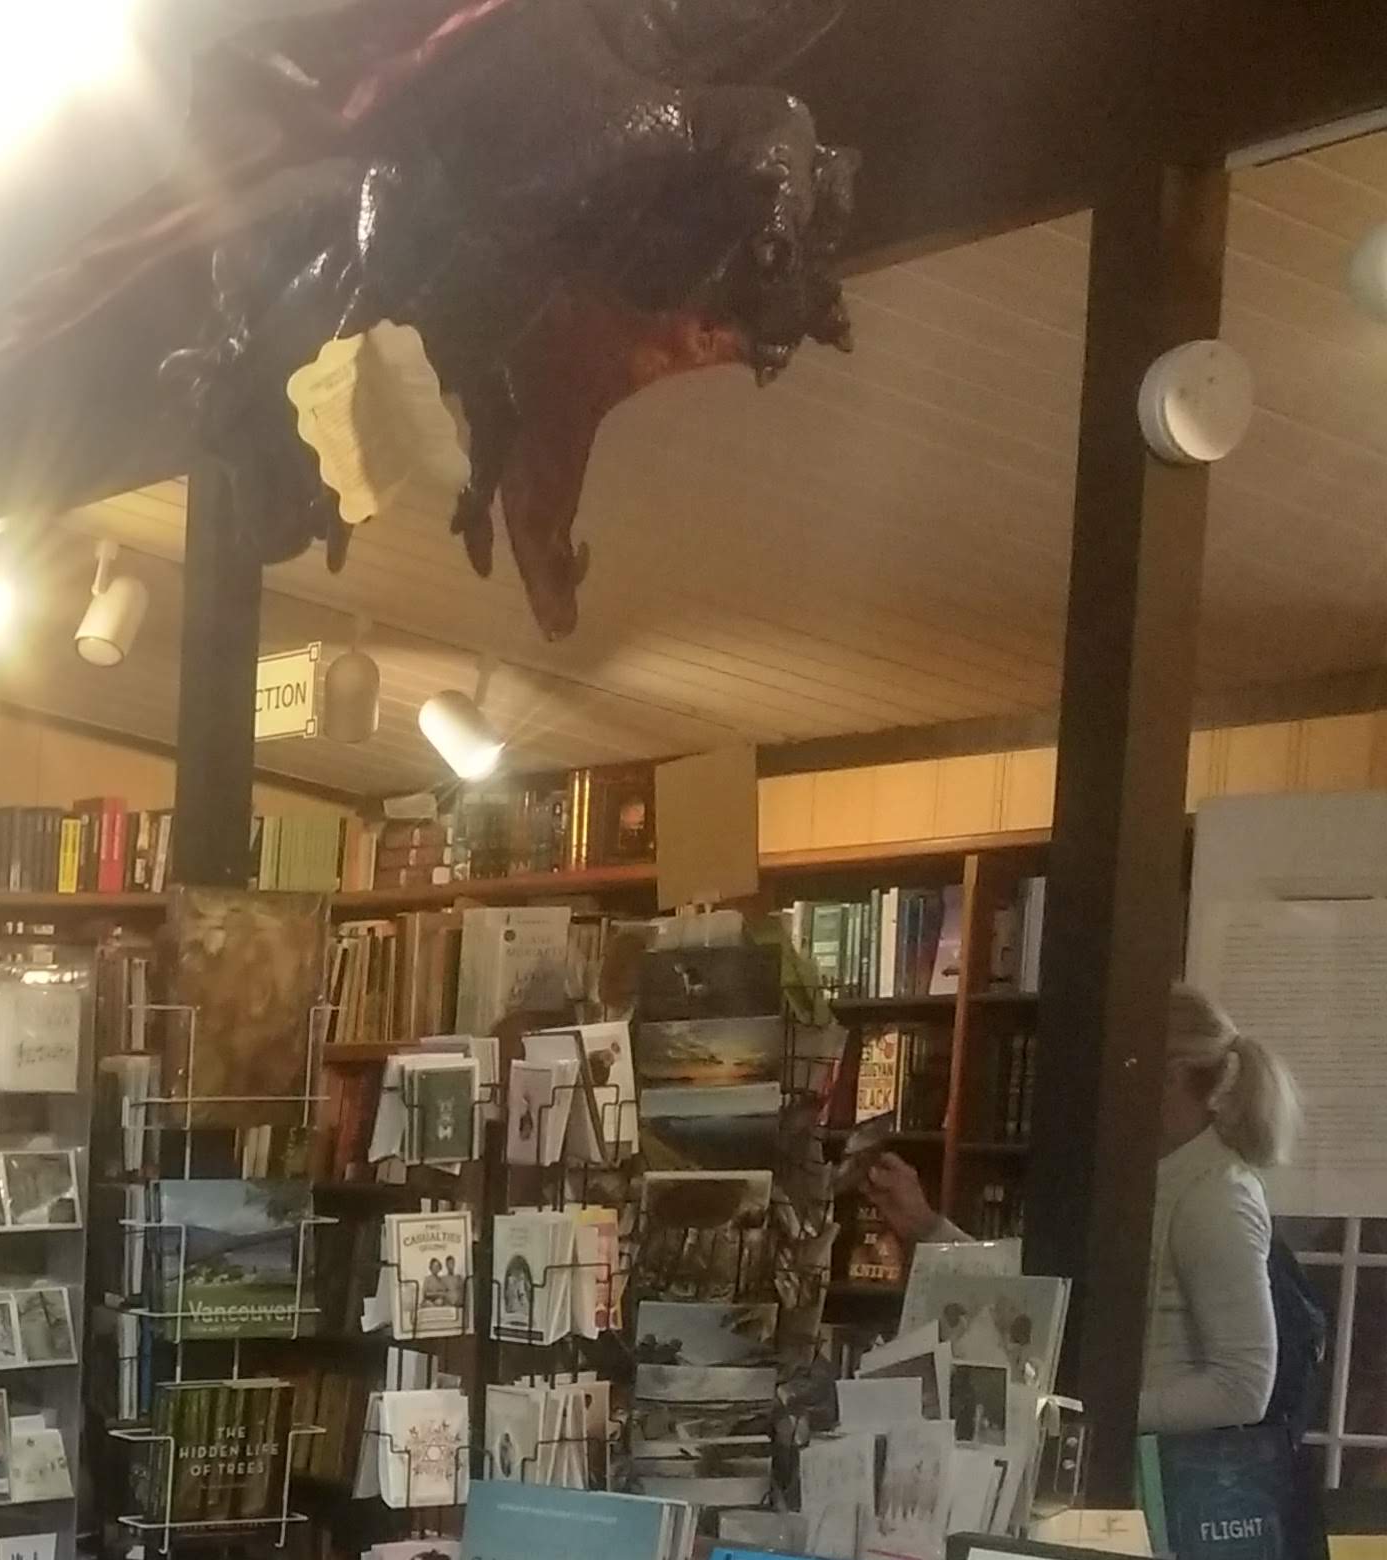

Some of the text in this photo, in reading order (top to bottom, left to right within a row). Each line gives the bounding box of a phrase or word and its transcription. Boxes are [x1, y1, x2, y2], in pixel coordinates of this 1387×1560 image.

[217, 1427, 246, 1441] THE
[179, 1443, 280, 1460] HIDDEN LIFE
[190, 1461, 265, 1476] OF TREES
[1200, 1517, 1265, 1540] FLIGHT
